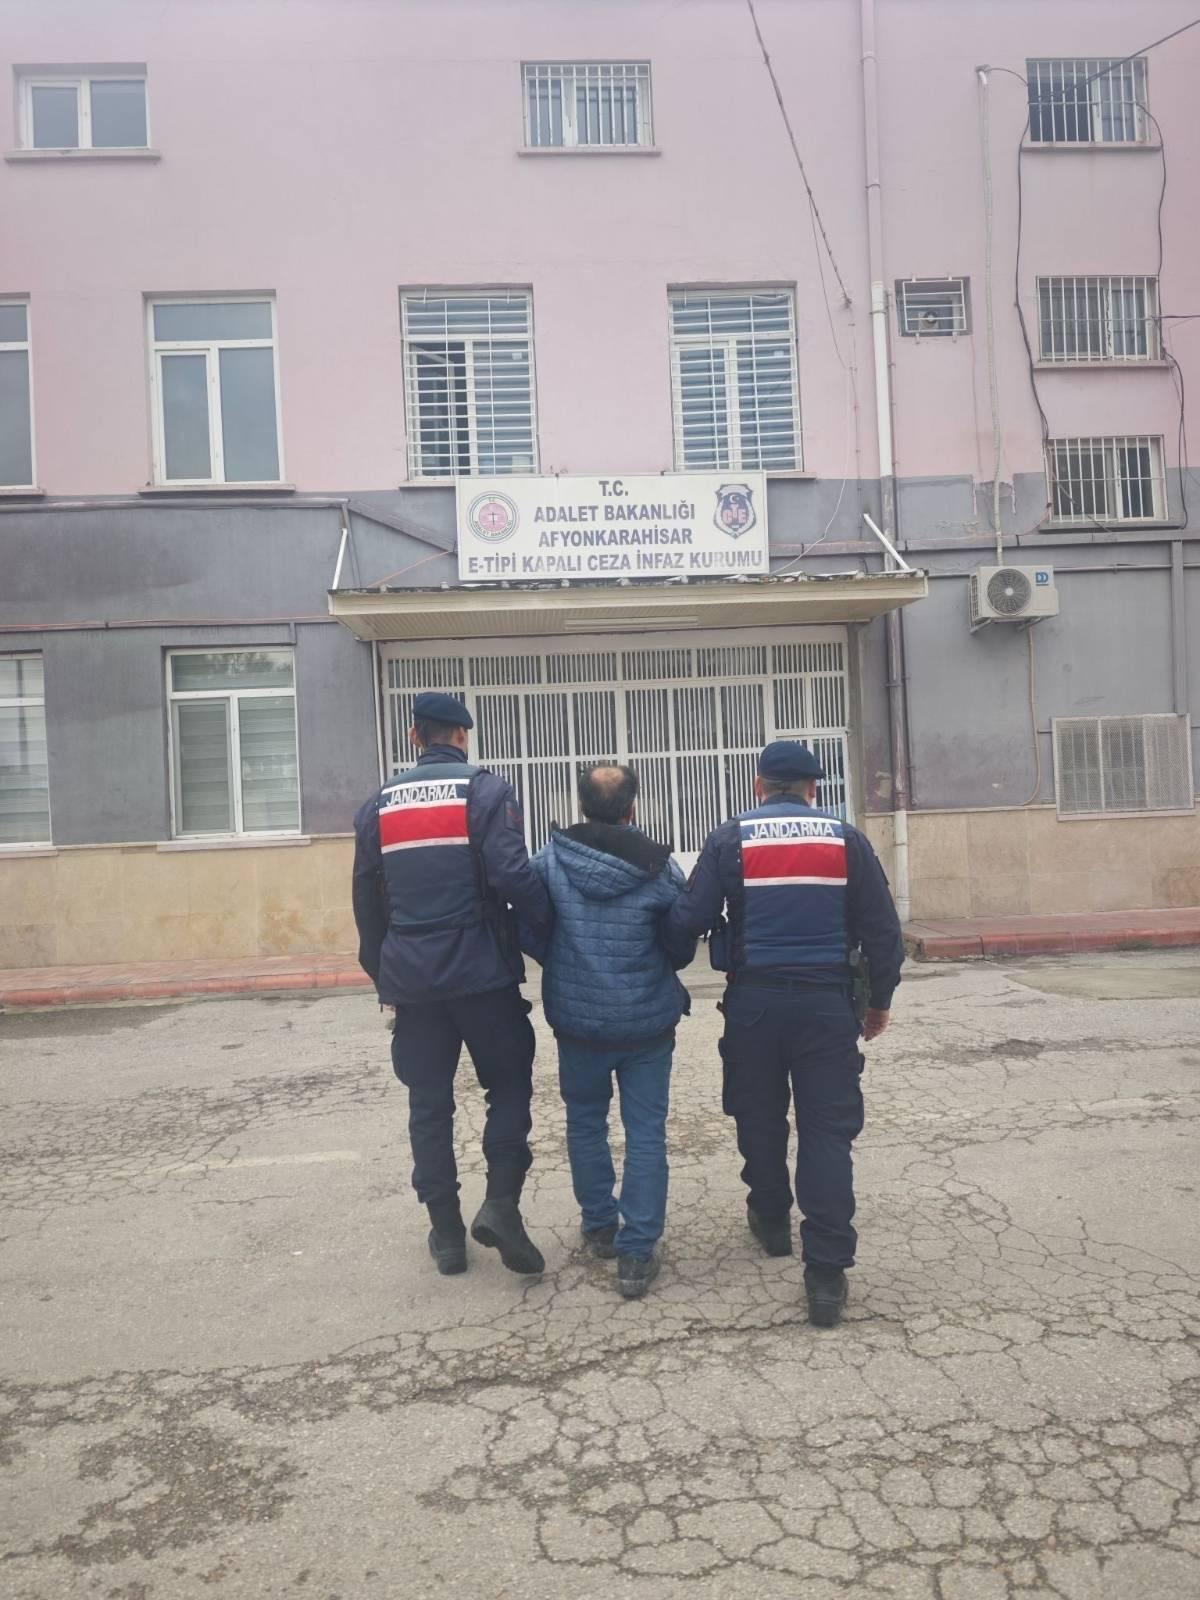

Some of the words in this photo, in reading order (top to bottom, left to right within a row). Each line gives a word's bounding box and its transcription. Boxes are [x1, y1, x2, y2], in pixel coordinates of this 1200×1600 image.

[599, 481, 629, 496] T.C.
[534, 506, 600, 522] ADALET
[604, 500, 695, 521] BAKANLIĞI
[538, 525, 693, 547] AFYONKARAHİSAR
[468, 553, 516, 573] E-TİPİ
[522, 555, 581, 572] KAPALI
[587, 553, 631, 571] CEZA
[636, 550, 684, 569] İNFAZ
[690, 550, 762, 568] KURUMU
[386, 784, 458, 806] JANDARMA
[749, 821, 835, 839] JANDARMA
